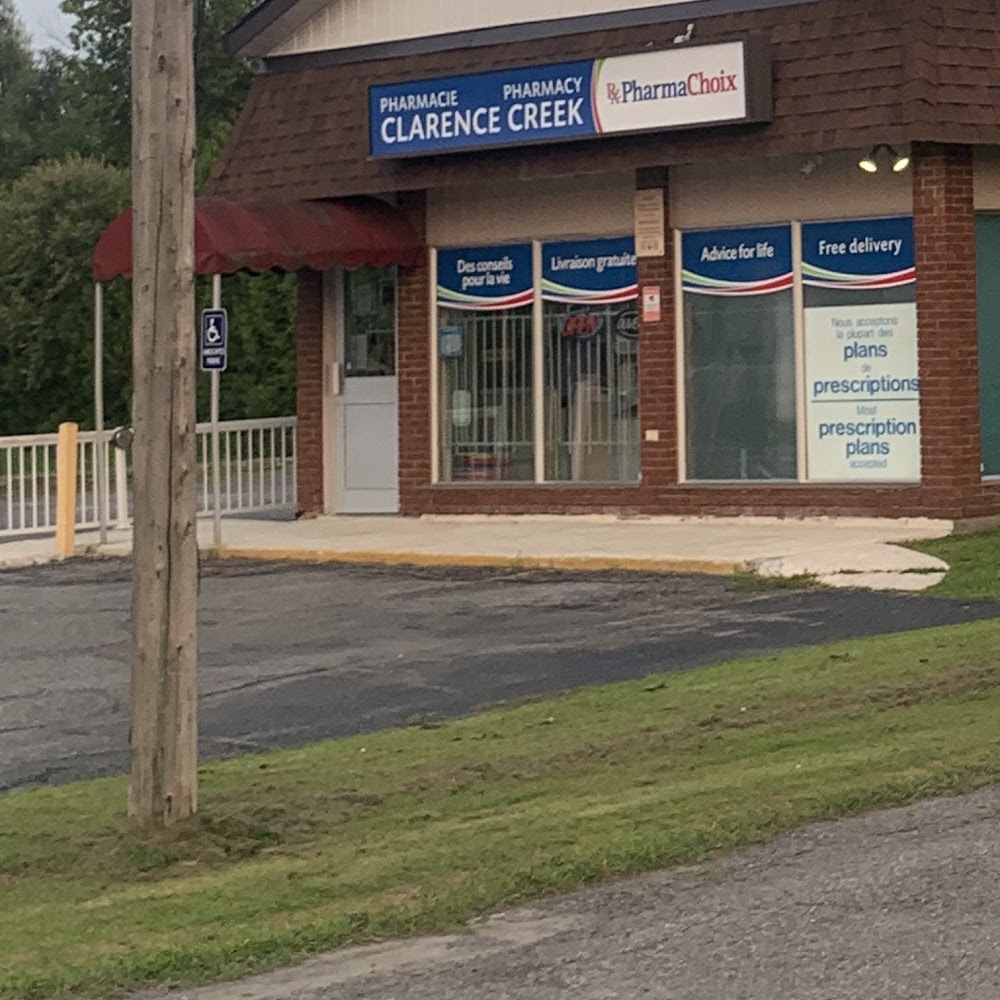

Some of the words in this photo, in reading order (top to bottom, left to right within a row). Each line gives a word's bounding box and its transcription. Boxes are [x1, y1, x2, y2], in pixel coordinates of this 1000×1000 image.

[380, 89, 459, 113] PHARMACIE
[503, 76, 583, 100] PHARMACY
[380, 106, 501, 144] CLARENCE
[507, 98, 584, 132] CREEK
[701, 245, 738, 262] Advice
[738, 243, 754, 259] for
[756, 241, 774, 258] life
[818, 239, 846, 256] Free
[849, 236, 902, 256] delivery
[457, 259, 475, 273] Des
[476, 255, 513, 273] conseils
[551, 254, 595, 271] Livraison
[596, 251, 637, 273] gratuite
[462, 276, 485, 291] pour
[486, 273, 496, 287] la
[496, 271, 510, 285] vie
[843, 341, 888, 362] plans
[813, 375, 920, 397] prescriptions
[819, 418, 916, 439] prescription
[846, 438, 890, 459] plans
